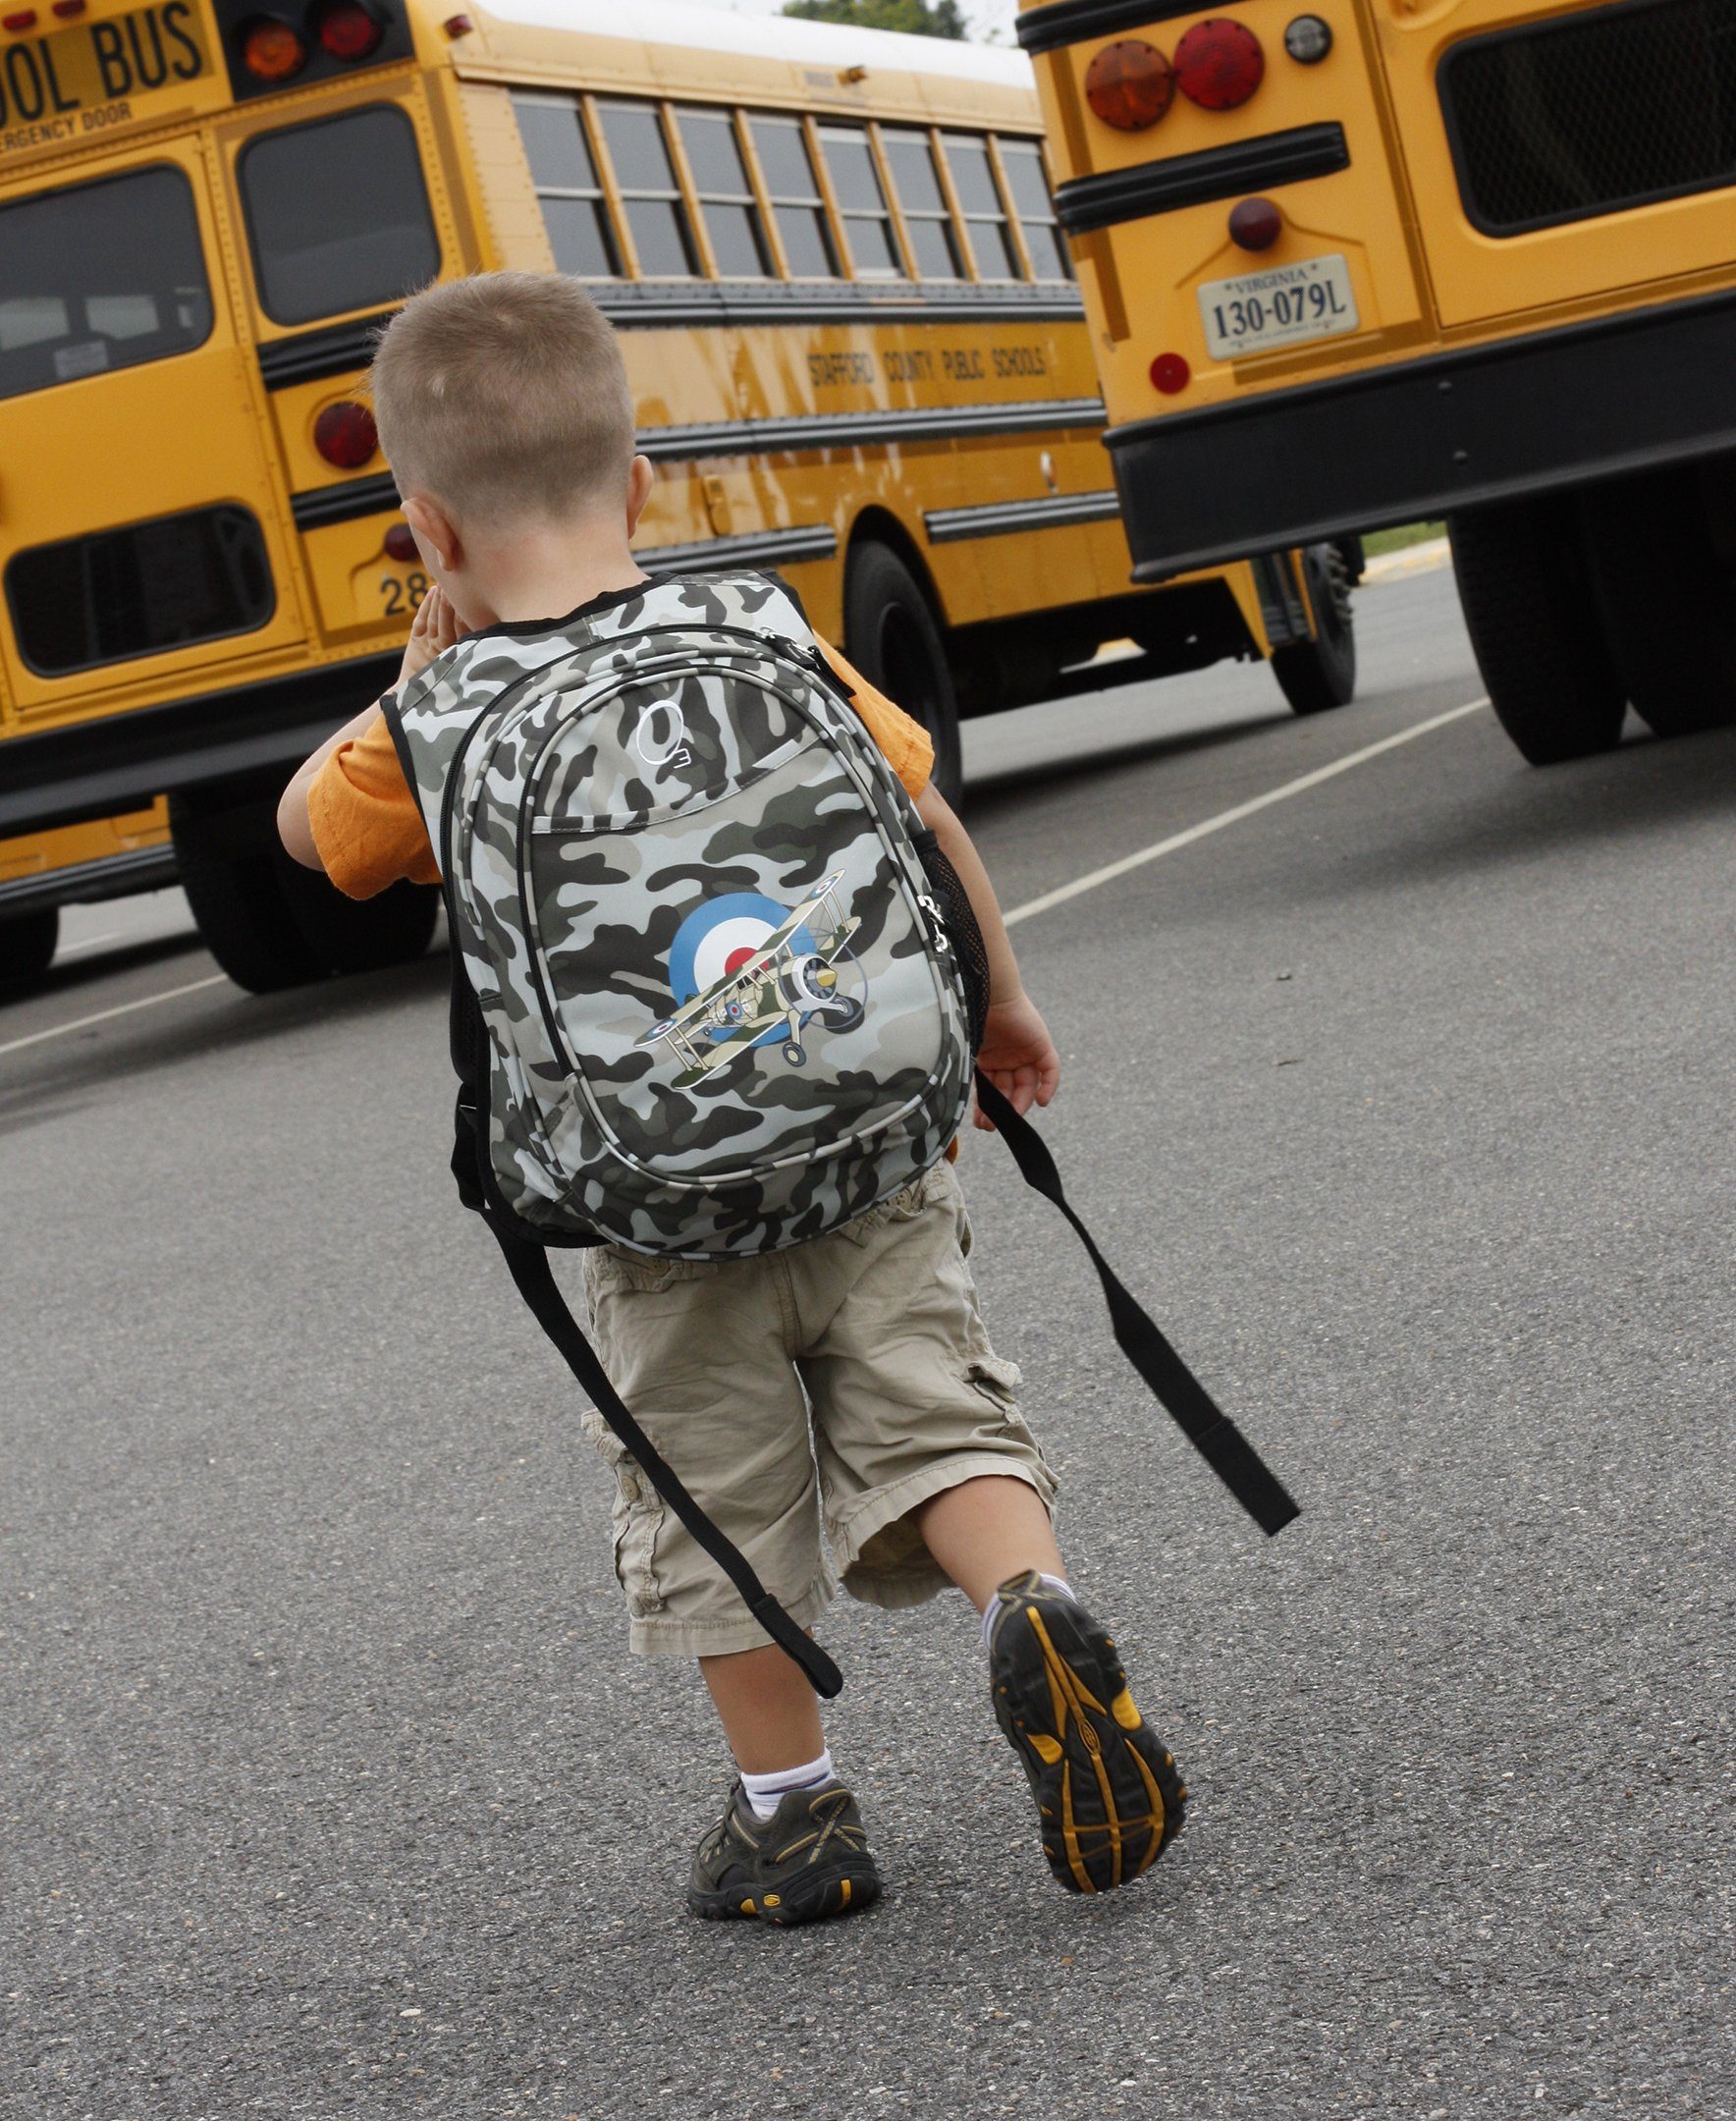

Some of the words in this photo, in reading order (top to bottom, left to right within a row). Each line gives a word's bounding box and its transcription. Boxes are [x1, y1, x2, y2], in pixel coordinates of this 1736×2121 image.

[0, 37, 81, 130] OL
[90, 1, 202, 99] BUS
[0, 117, 76, 153] RGENCY
[81, 101, 133, 131] DOOR
[1235, 268, 1309, 295] VIRGINIA
[1214, 280, 1346, 339] 130-079L
[806, 351, 876, 388] STAFFORD
[883, 350, 935, 383] COUNTY
[942, 348, 985, 382] PUBLIC
[991, 346, 1047, 379] SCHOOLS
